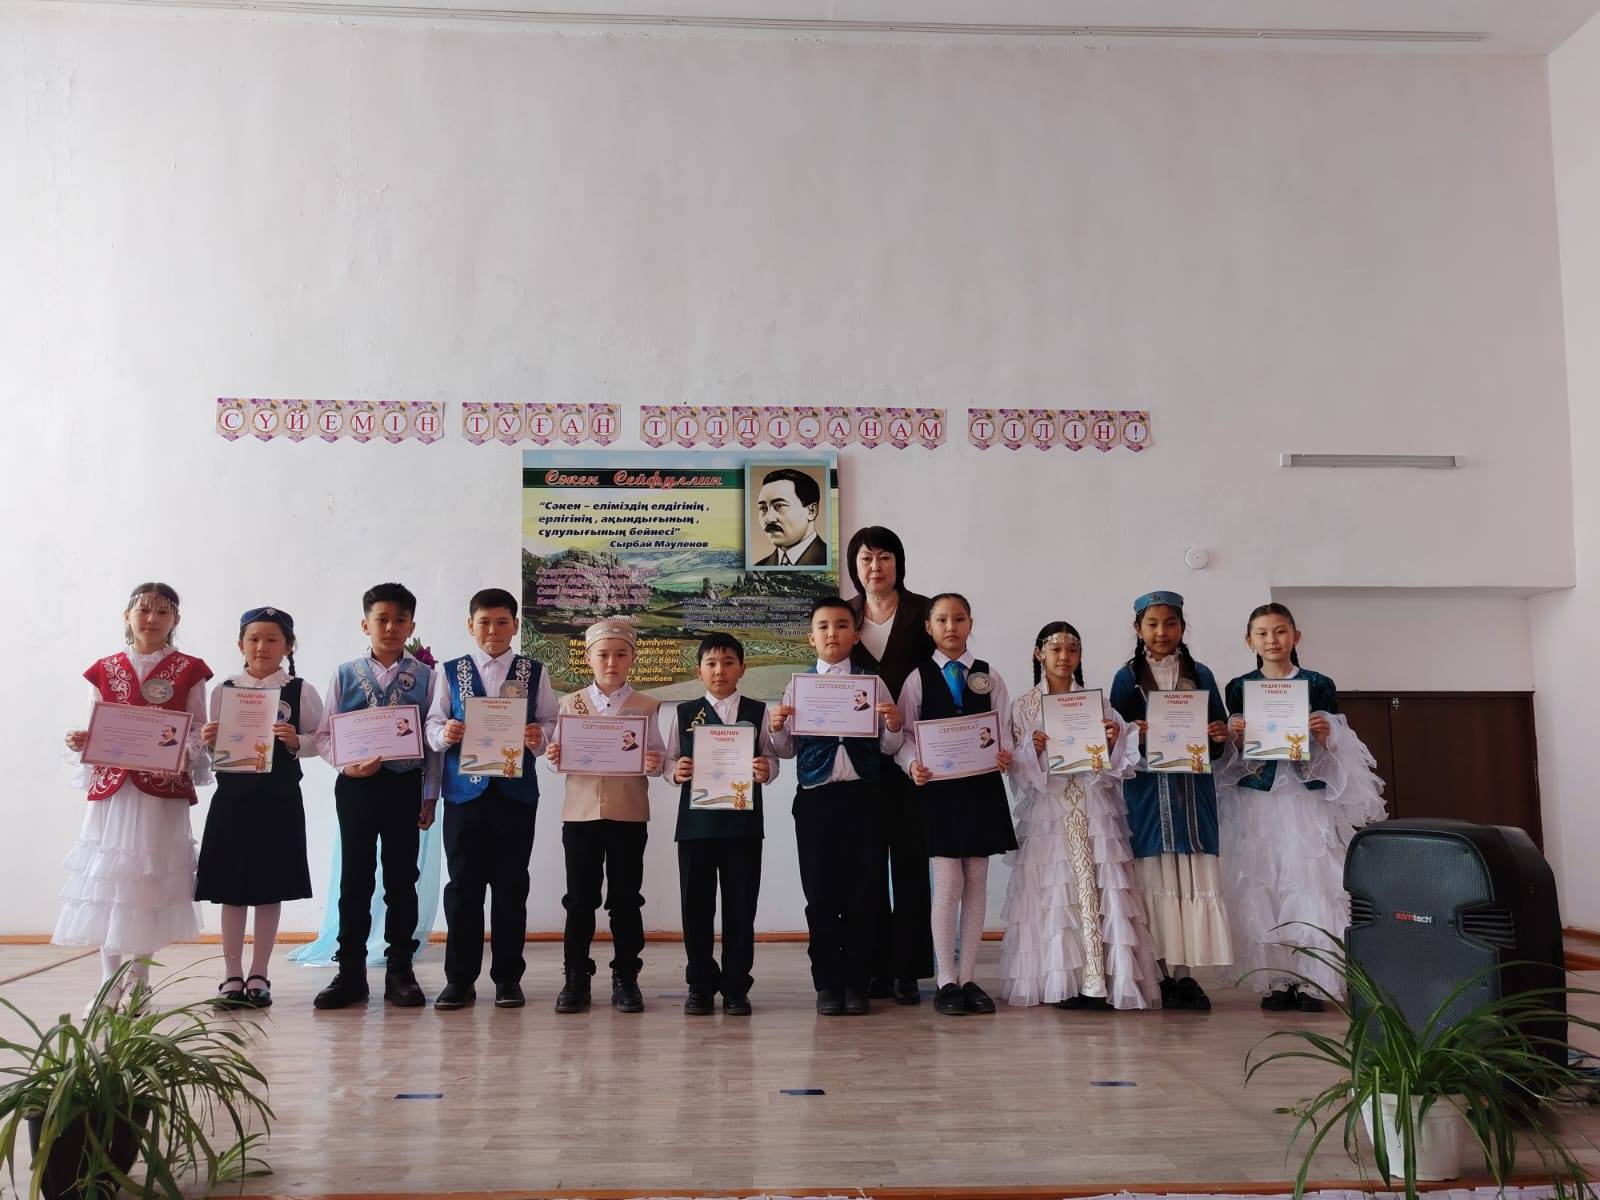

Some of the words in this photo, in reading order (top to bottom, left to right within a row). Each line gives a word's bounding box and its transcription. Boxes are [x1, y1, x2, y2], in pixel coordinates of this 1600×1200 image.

[223, 409, 437, 432] СҮЙЕМІН
[470, 412, 612, 433] ТУҒАН
[975, 422, 1139, 441] ТІЛІН!
[544, 469, 600, 486] Сәкен
[613, 469, 723, 491] Сейфуллин
[592, 500, 649, 513] еліміздің
[538, 527, 627, 538] сұлулығының
